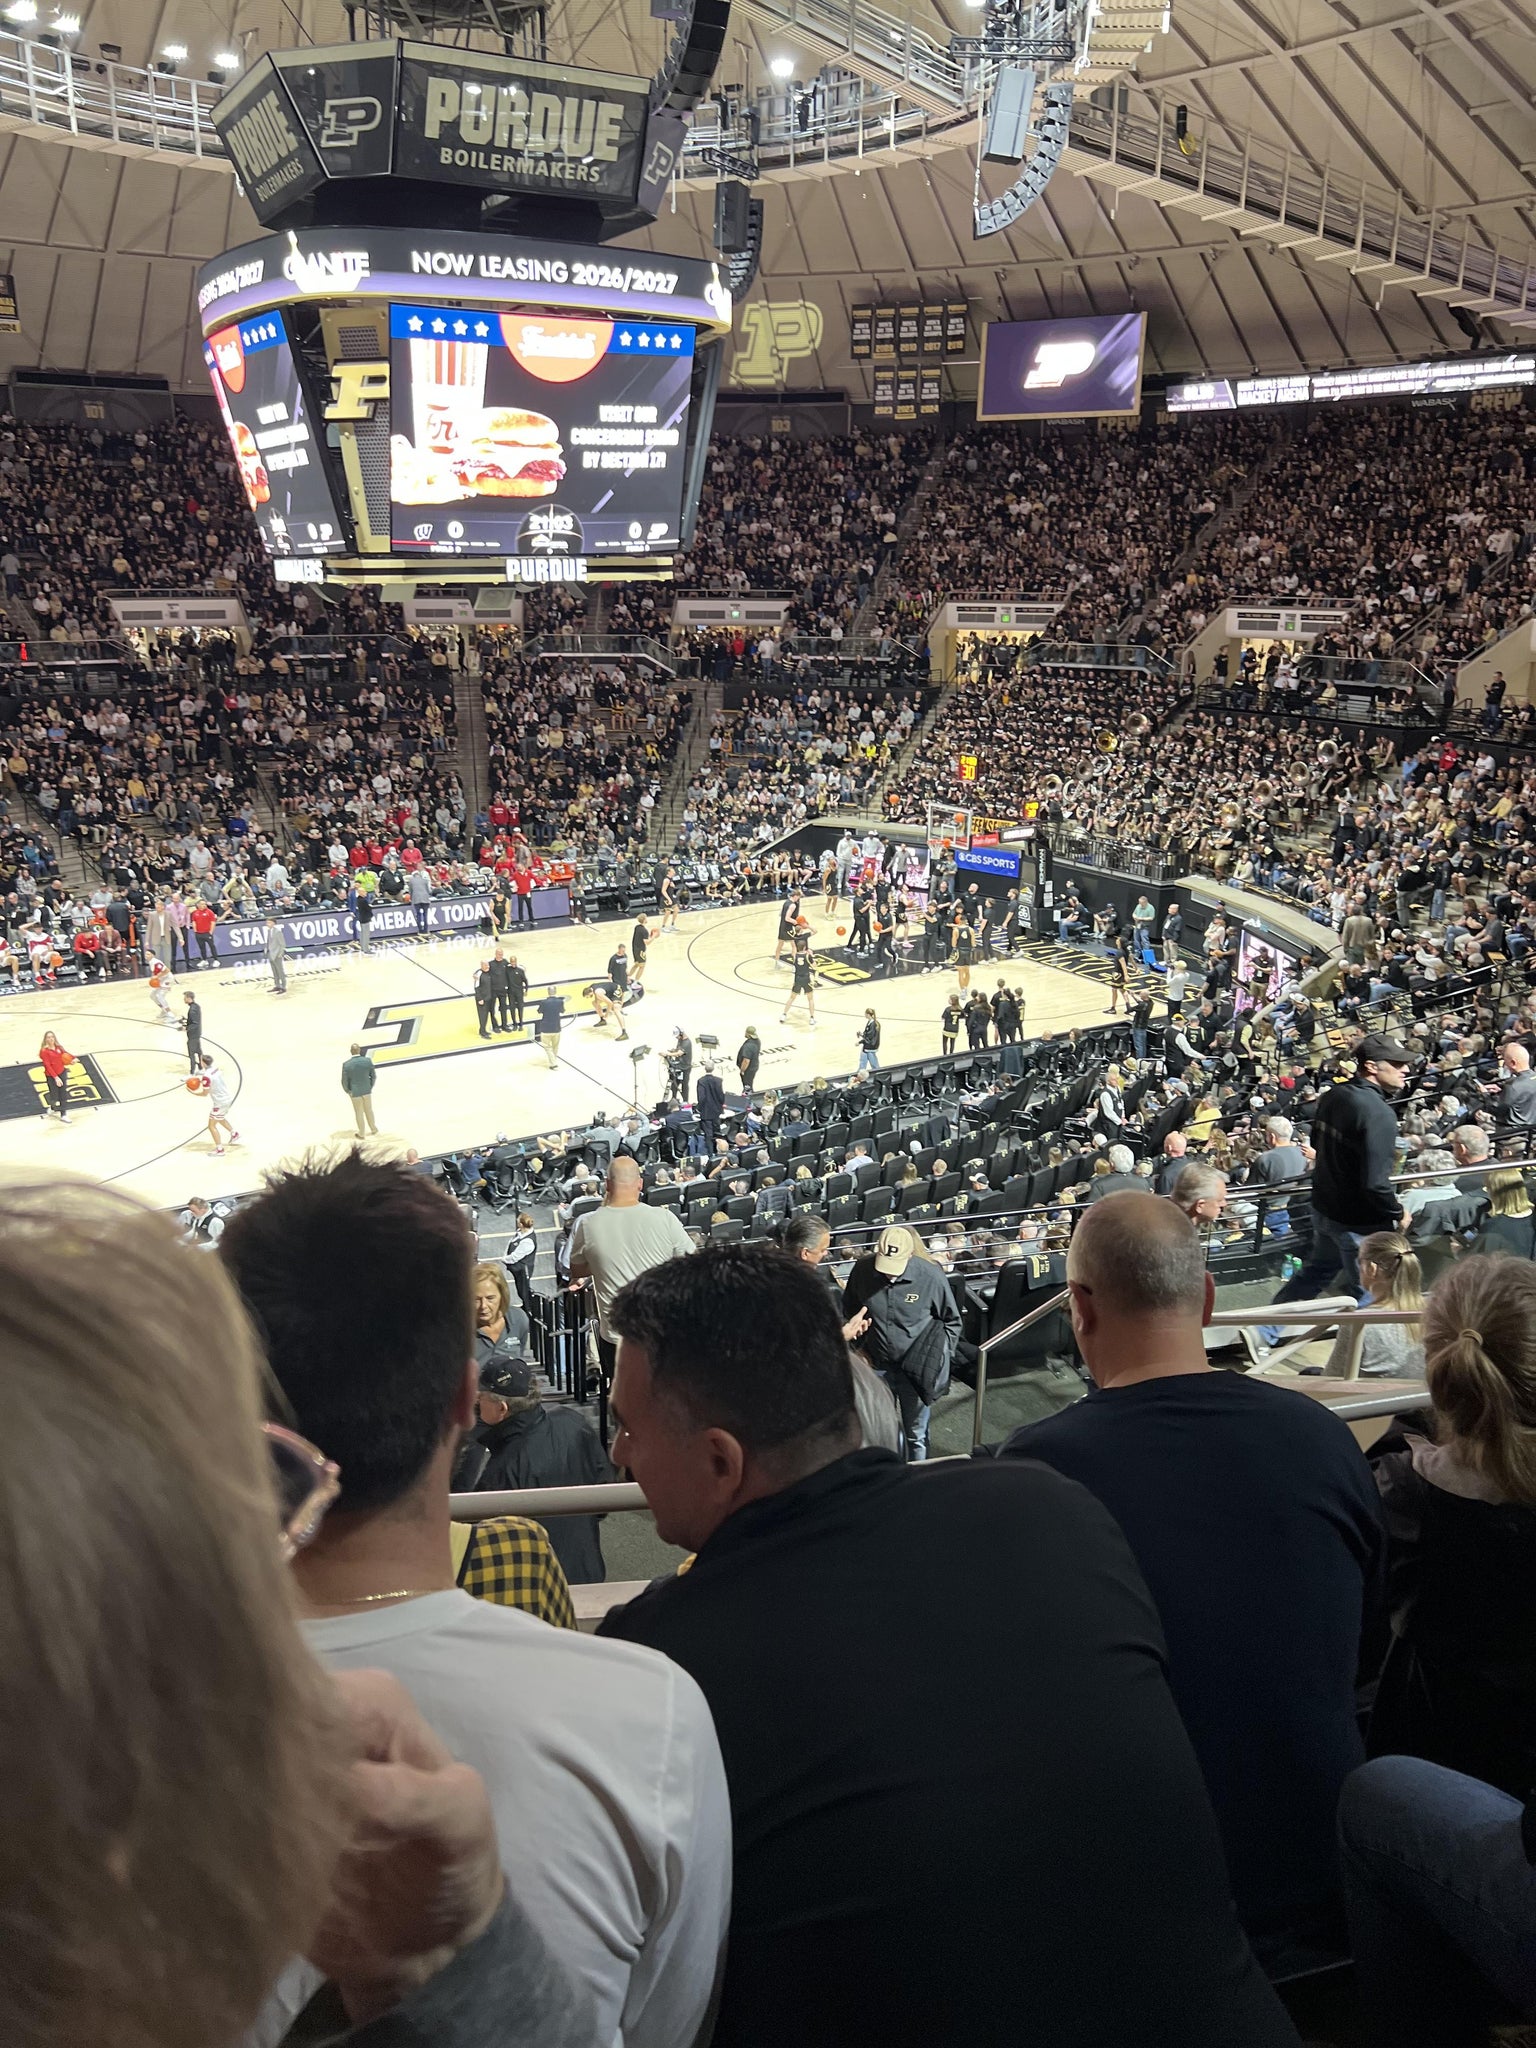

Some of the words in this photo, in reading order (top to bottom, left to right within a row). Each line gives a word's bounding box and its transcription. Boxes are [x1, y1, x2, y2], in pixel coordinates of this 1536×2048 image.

[226, 89, 299, 185] PURDUE
[320, 97, 382, 148] P
[425, 76, 625, 162] PURDUE
[256, 158, 304, 202] BOILERMAKERS
[440, 147, 600, 183] BOILERMAKERS
[411, 251, 474, 276] NOW
[480, 255, 569, 283] LEASING
[572, 264, 679, 295] 2026/2027
[729, 301, 823, 385] P
[1023, 342, 1096, 389] P
[324, 362, 390, 419] P
[1237, 390, 1276, 405] MACKEY
[1277, 386, 1309, 402] ARENA
[506, 558, 588, 582] PURDUE
[965, 853, 982, 864] CBS
[983, 857, 1016, 870] SPORTS
[288, 919, 345, 941] YOUR
[345, 907, 438, 936] CMEBAK
[441, 901, 494, 923] TODAY
[1190, 1034, 1197, 1043] 3
[885, 1245, 898, 1256] P
[905, 1294, 919, 1303] P
